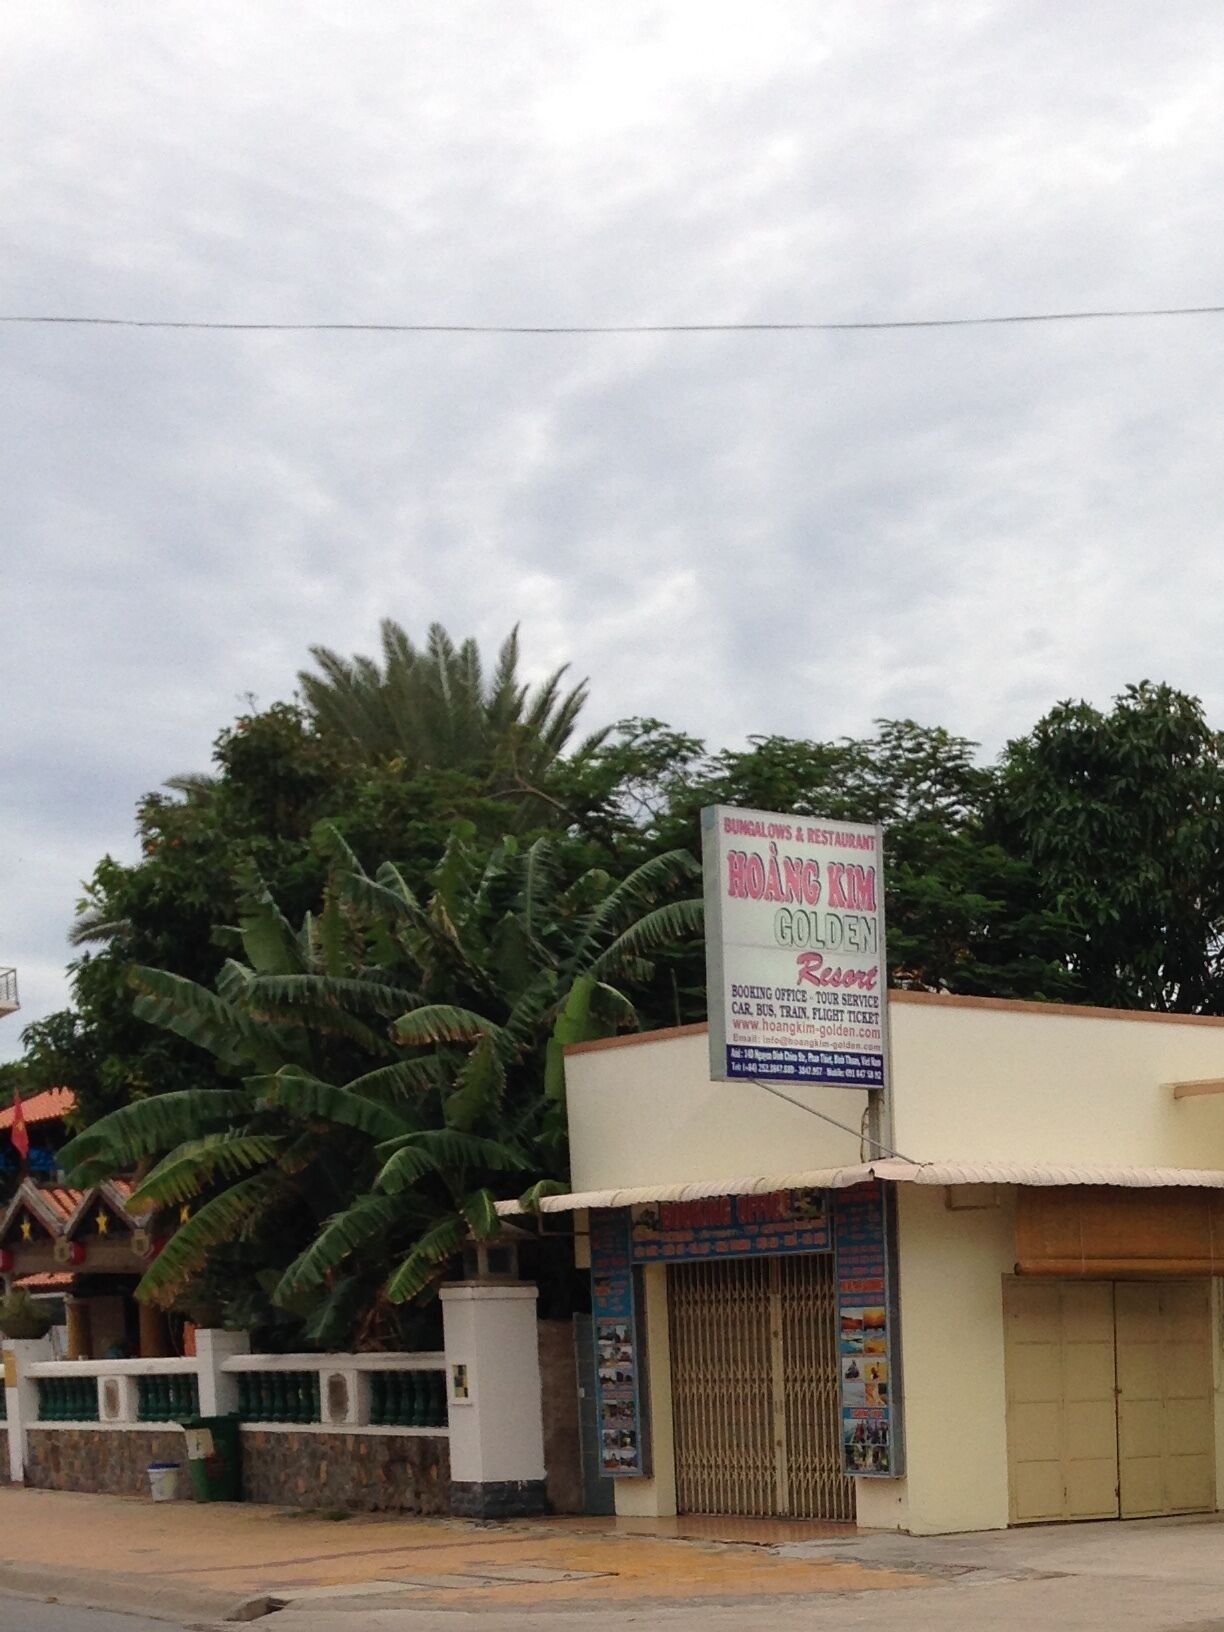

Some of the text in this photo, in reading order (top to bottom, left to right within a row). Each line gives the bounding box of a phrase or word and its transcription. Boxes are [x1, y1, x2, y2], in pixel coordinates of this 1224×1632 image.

[723, 817, 876, 851] BUNGALOWS & RESTAURANT
[826, 861, 877, 913] KIM
[774, 907, 878, 955] GOLDEN
[796, 951, 878, 991] Resort
[731, 984, 773, 1001] BOOKING
[775, 987, 807, 1003] OFFICE
[816, 991, 839, 1007] TOUR
[842, 992, 879, 1009] SERVICE
[812, 1007, 844, 1021] FLIGHT
[847, 1010, 880, 1025] TICKET
